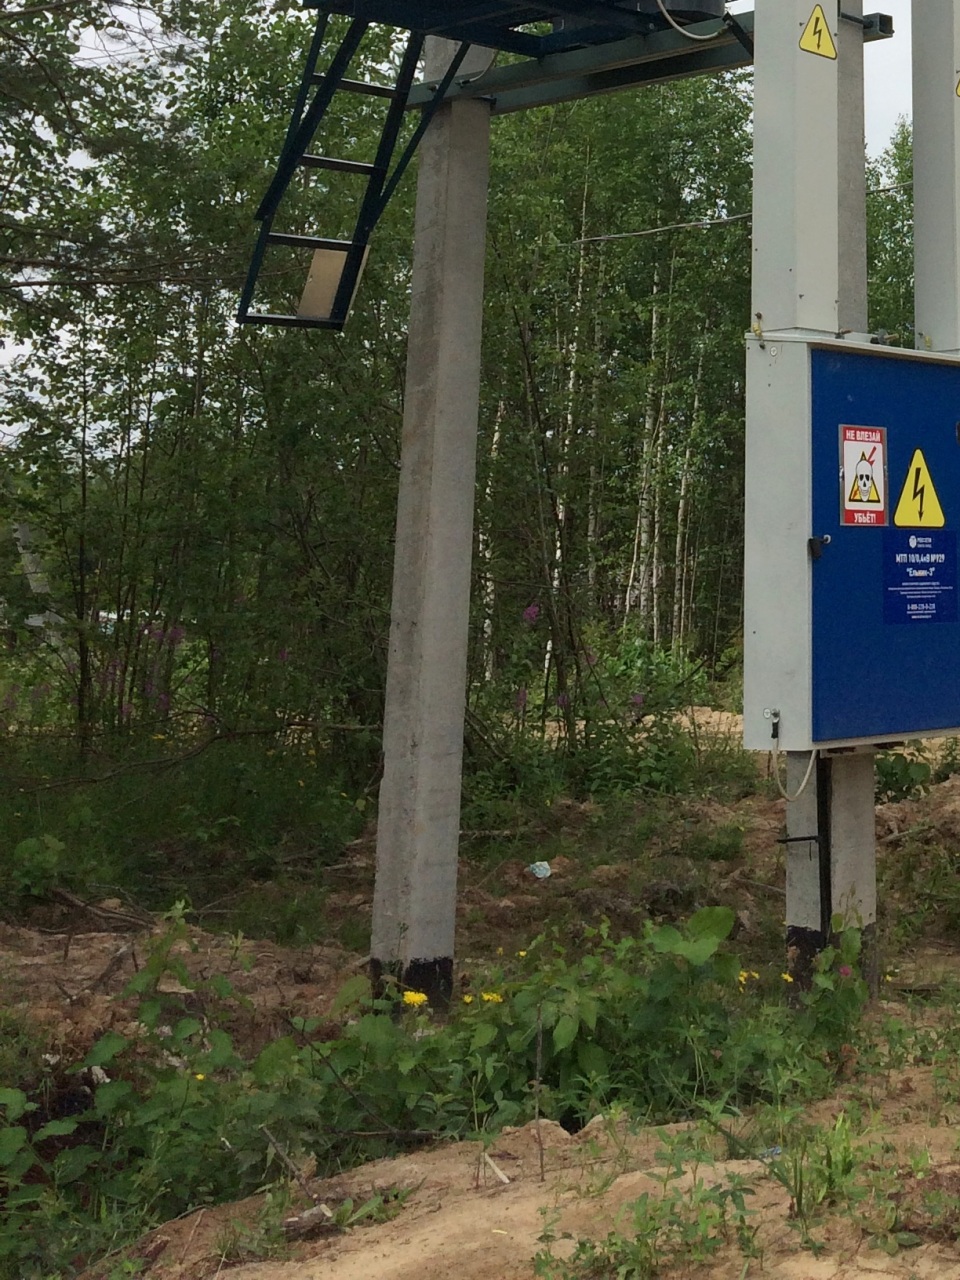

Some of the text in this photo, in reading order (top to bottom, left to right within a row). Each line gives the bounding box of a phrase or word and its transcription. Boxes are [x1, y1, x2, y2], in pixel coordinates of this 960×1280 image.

[846, 430, 880, 442] НЕ ВЛЕЗАЙ
[895, 553, 908, 563] МТП
